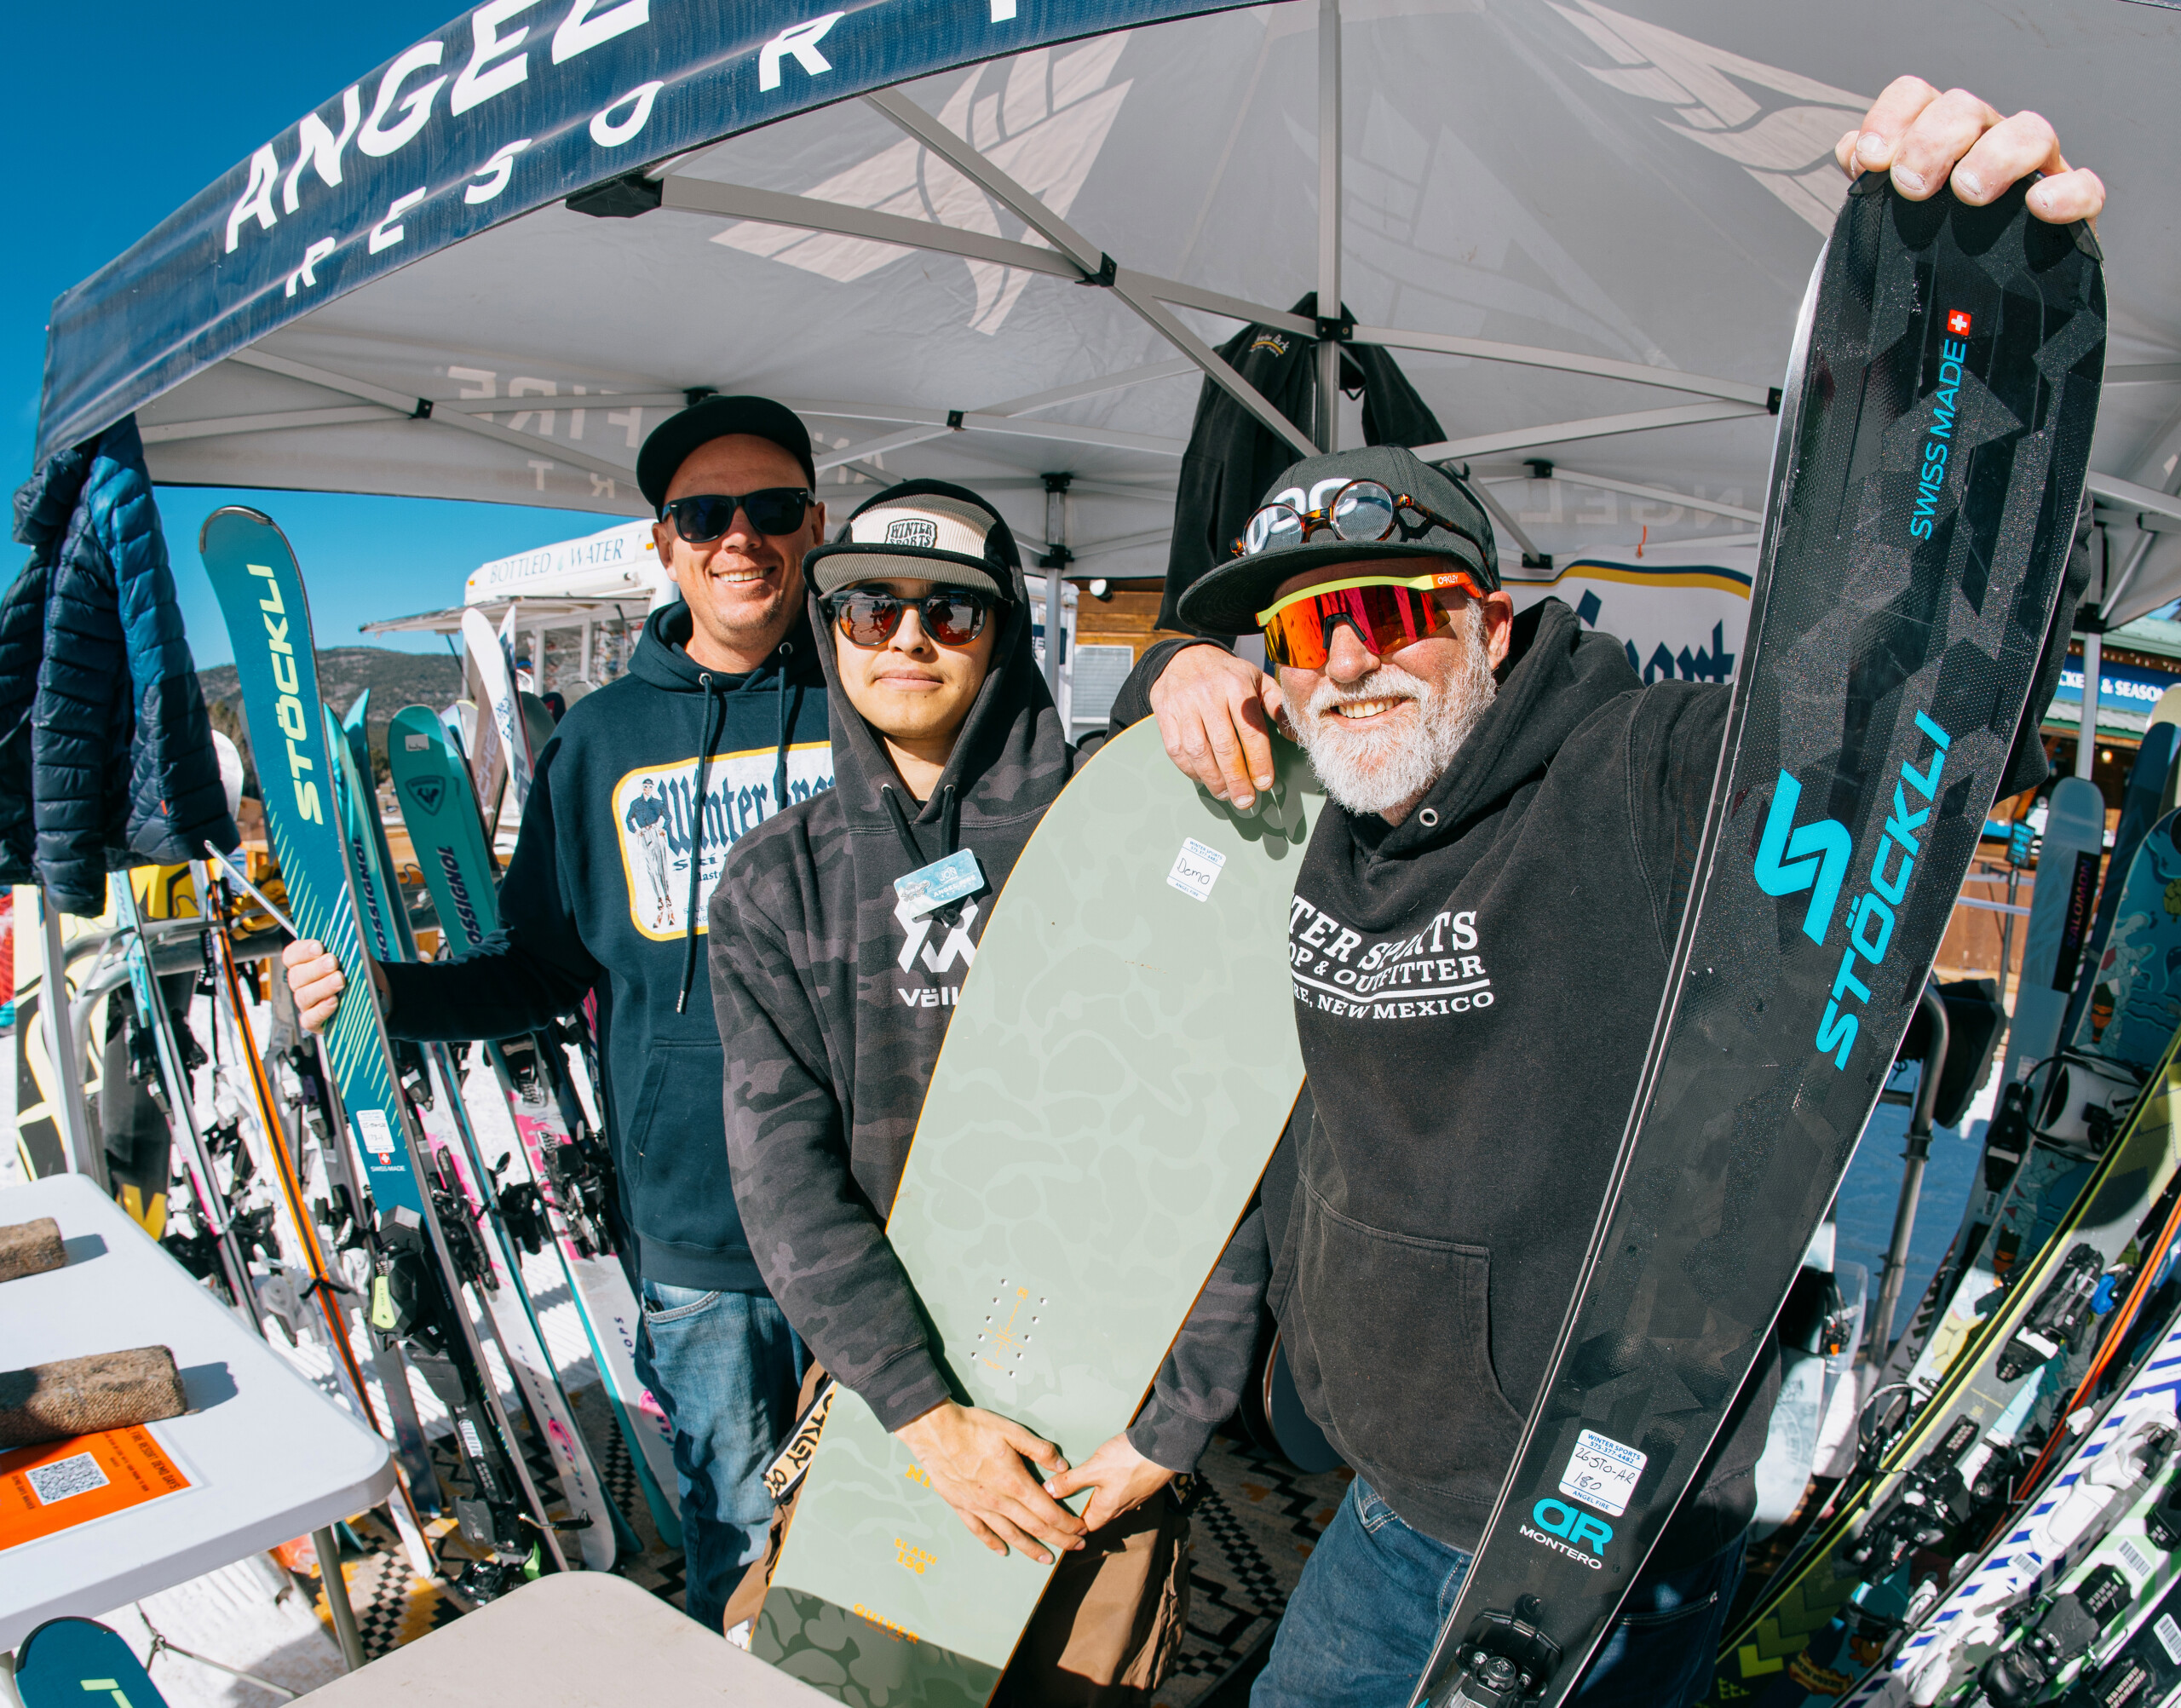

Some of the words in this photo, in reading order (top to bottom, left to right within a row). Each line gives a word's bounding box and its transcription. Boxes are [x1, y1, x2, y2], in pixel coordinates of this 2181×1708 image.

[285, 0, 1017, 297] RESOR
[1910, 441, 1948, 541] SWISS
[1930, 339, 1967, 439] MADE
[891, 522, 932, 538] WINTER
[490, 553, 551, 584] BOTTLED
[571, 538, 624, 566] WATER
[1437, 574, 1459, 585] OAKLEY
[246, 563, 324, 825] STÖCKLI
[2101, 678, 2113, 694] &
[940, 866, 958, 882] JON
[1177, 857, 1211, 885] Demo
[436, 846, 484, 945] OSSIGNOL
[1816, 709, 1951, 1071] STÖCKLI
[2067, 859, 2092, 950] SALOMON
[1314, 960, 1330, 976] &
[1333, 955, 1486, 993] OUTFITTER
[1317, 994, 1371, 1019] NEW
[1372, 991, 1494, 1020] MEXICO
[1587, 1433, 1614, 1449] WINTER
[1614, 1444, 1641, 1461] SPORTS
[1590, 1441, 1635, 1464] 575-377-4482
[1574, 1471, 1602, 1491] 180
[1572, 1490, 1594, 1504] ANGEL
[1595, 1499, 1610, 1510] FIRE
[894, 1538, 938, 1566] SLASH
[1519, 1524, 1603, 1570] MONTERO
[896, 1550, 926, 1575] 156
[853, 1602, 920, 1645] QUIVER
